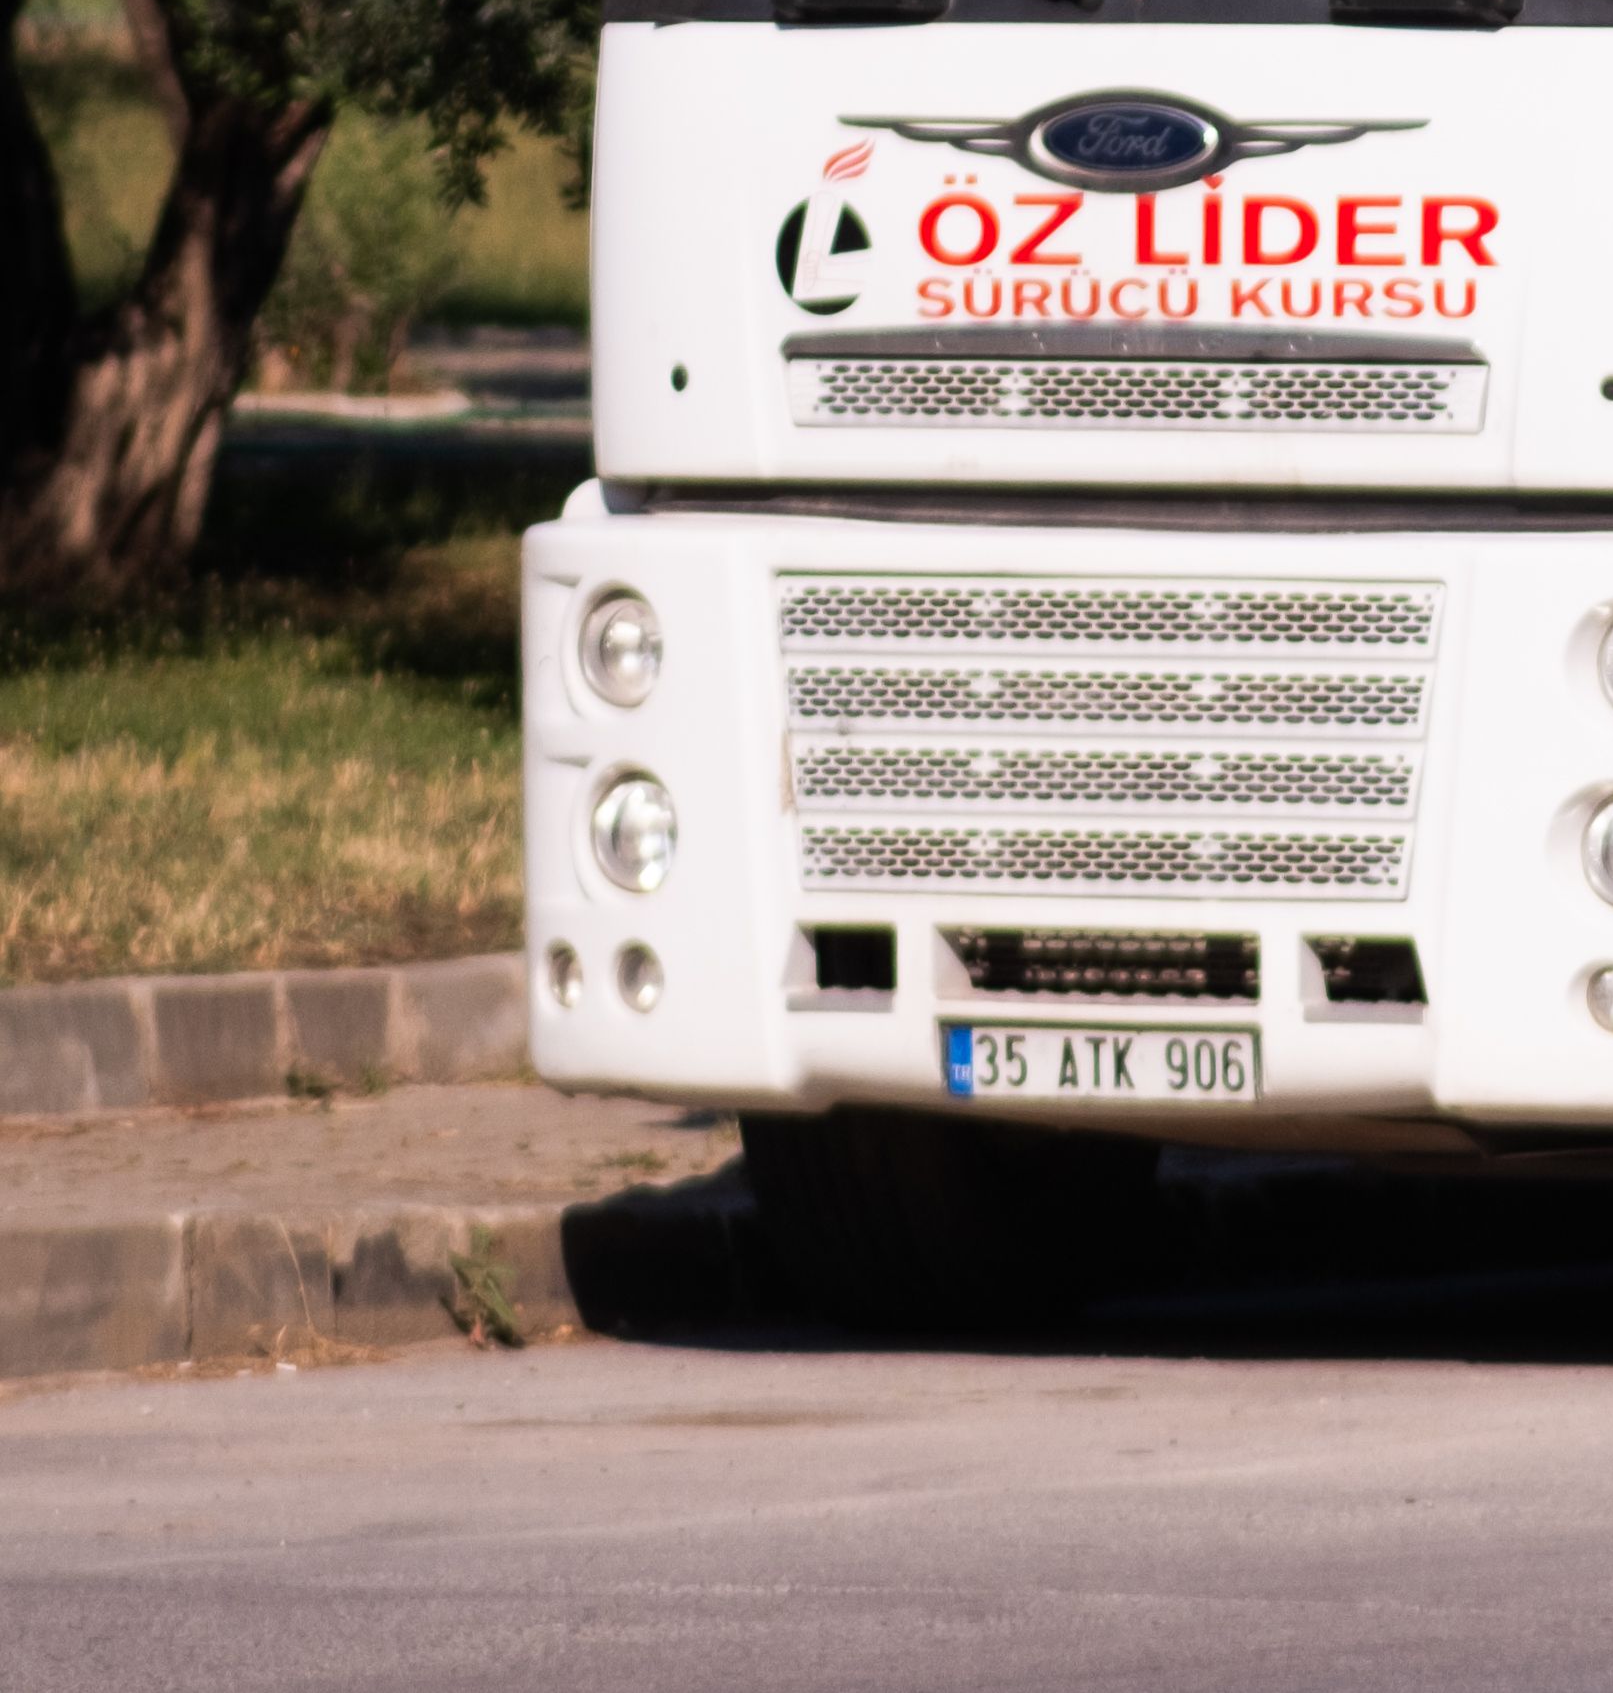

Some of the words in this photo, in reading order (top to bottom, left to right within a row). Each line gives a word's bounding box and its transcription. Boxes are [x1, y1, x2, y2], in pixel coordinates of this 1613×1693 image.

[1078, 114, 1171, 156] Ford
[918, 174, 1085, 267] ÖZ
[1135, 175, 1499, 267] LİDER
[916, 268, 1199, 319] SÜRÜCÜ
[1231, 278, 1478, 319] KURSU
[975, 1033, 1028, 1088] 35
[1058, 1035, 1135, 1090] ATK
[1164, 1037, 1246, 1093] 906
